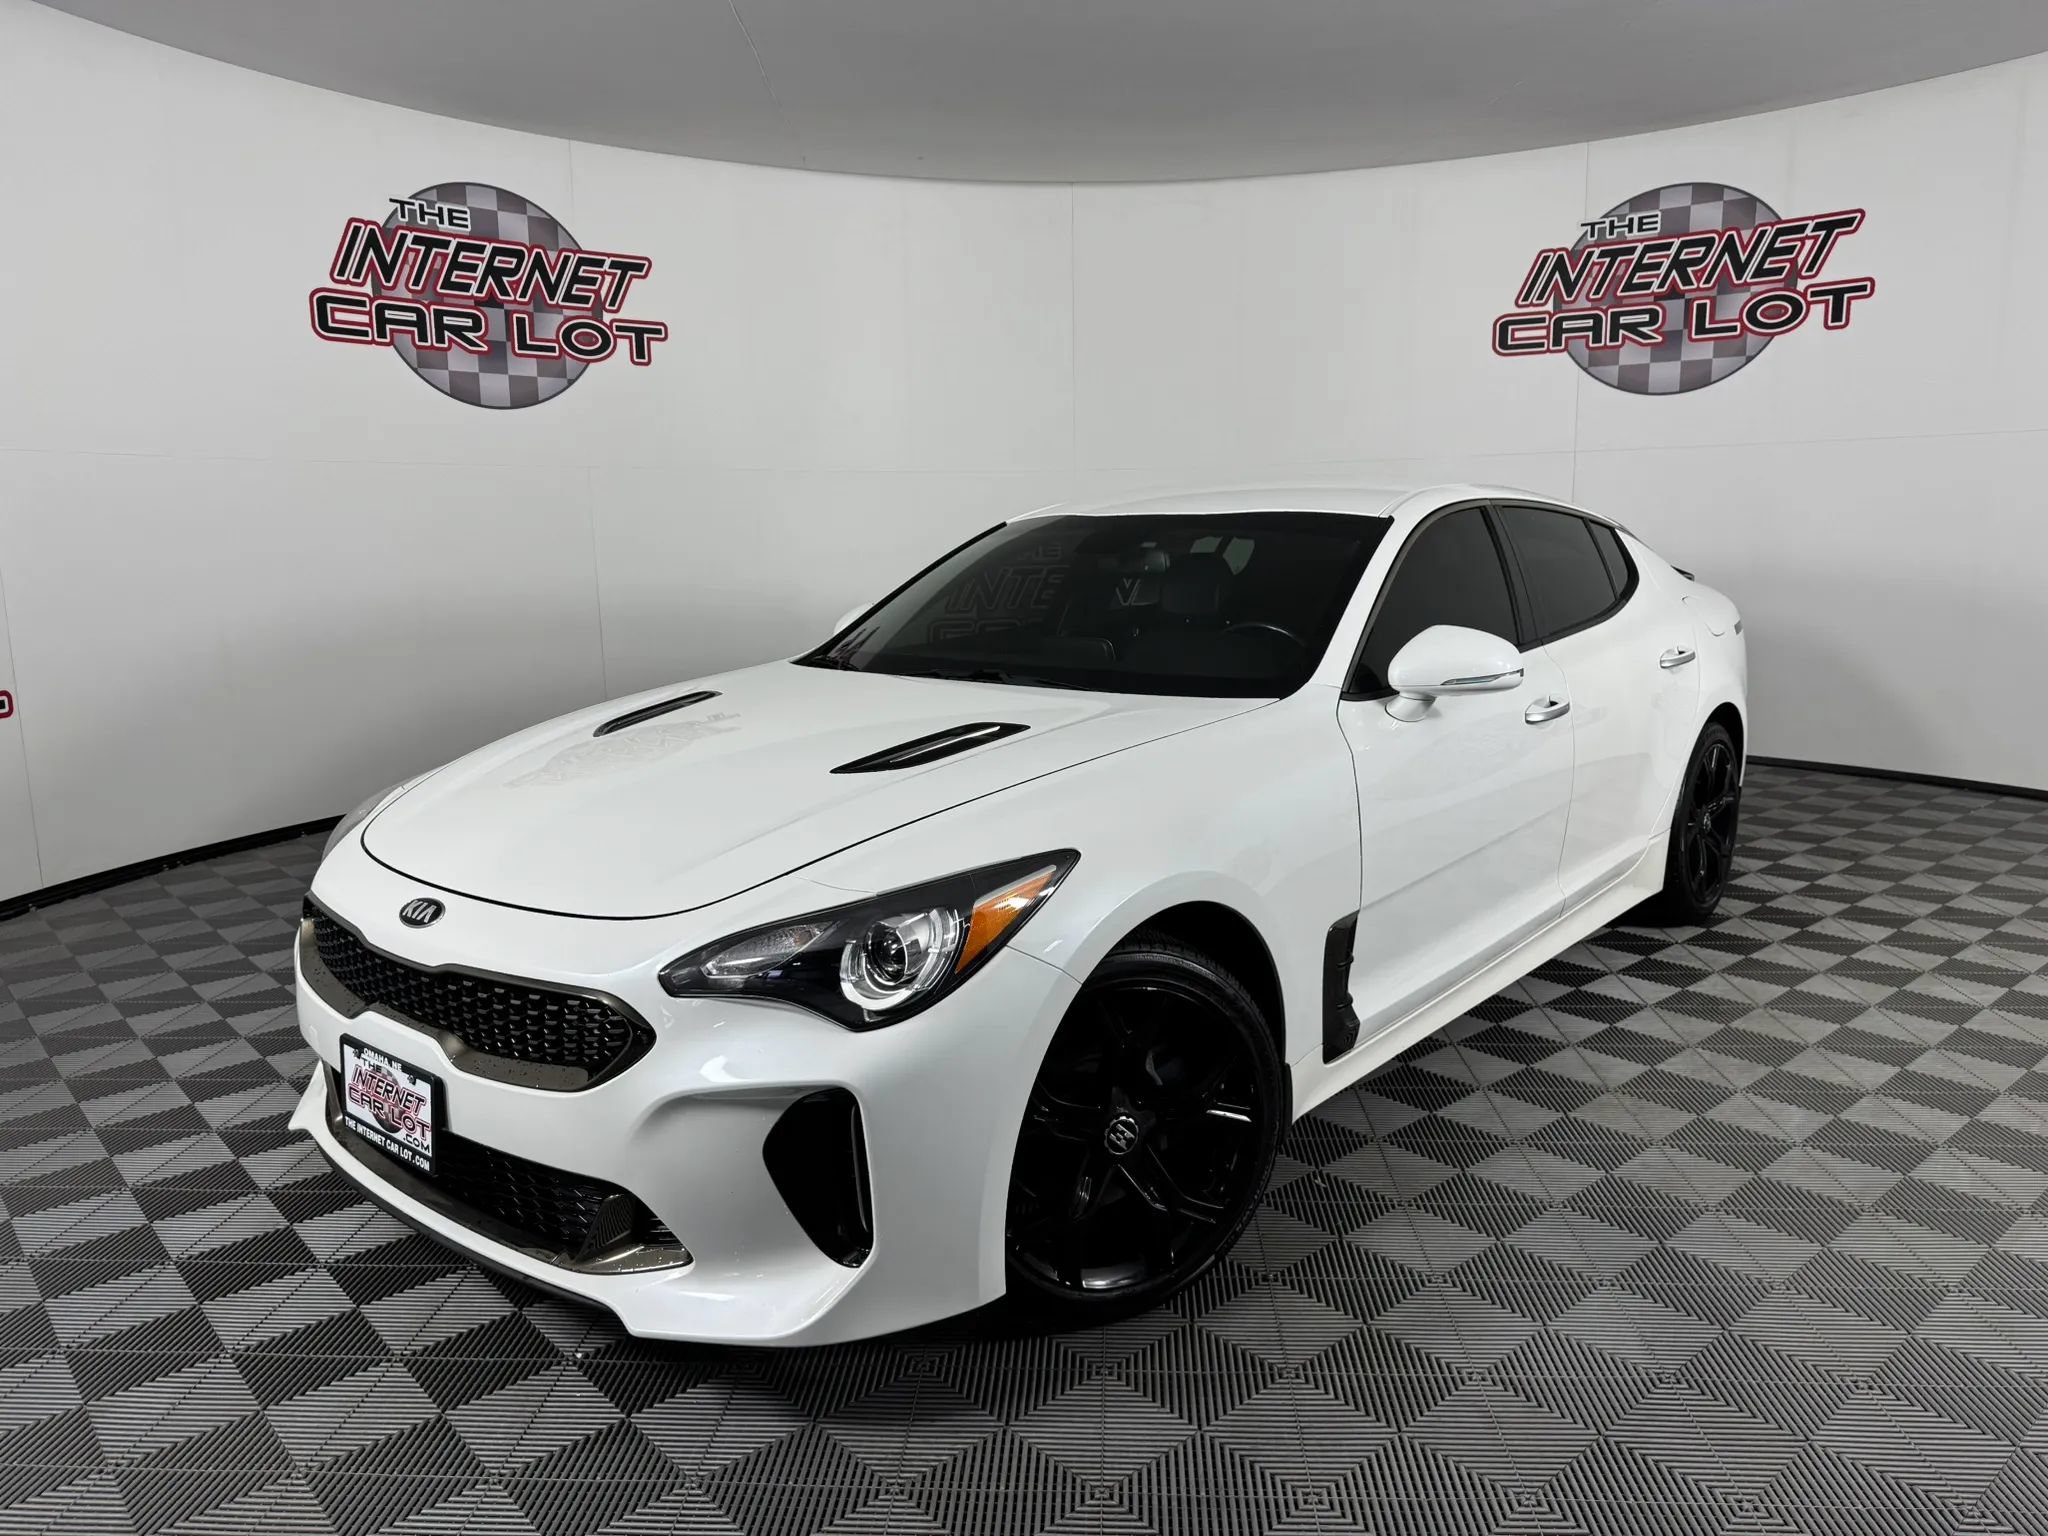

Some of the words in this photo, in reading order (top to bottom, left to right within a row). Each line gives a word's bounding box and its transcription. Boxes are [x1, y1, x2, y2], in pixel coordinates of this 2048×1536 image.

[388, 197, 472, 231] THE
[1580, 211, 1662, 240] THE
[332, 219, 650, 312] INTERNET
[1518, 210, 1864, 306] INTERNET
[312, 289, 490, 353] CAR
[510, 311, 667, 366] LOT
[1494, 302, 1665, 356] CAR
[1689, 278, 1874, 341] LOT
[402, 899, 437, 923] KIA
[360, 1057, 382, 1073] THE
[391, 1060, 402, 1072] NE
[352, 1064, 427, 1116] INTERNET
[348, 1084, 387, 1119] CAR
[390, 1104, 431, 1141] LOT
[345, 1116, 356, 1131] THE
[356, 1123, 386, 1146] INTERNET
[386, 1139, 399, 1155] CAR
[403, 1134, 430, 1154] .COM
